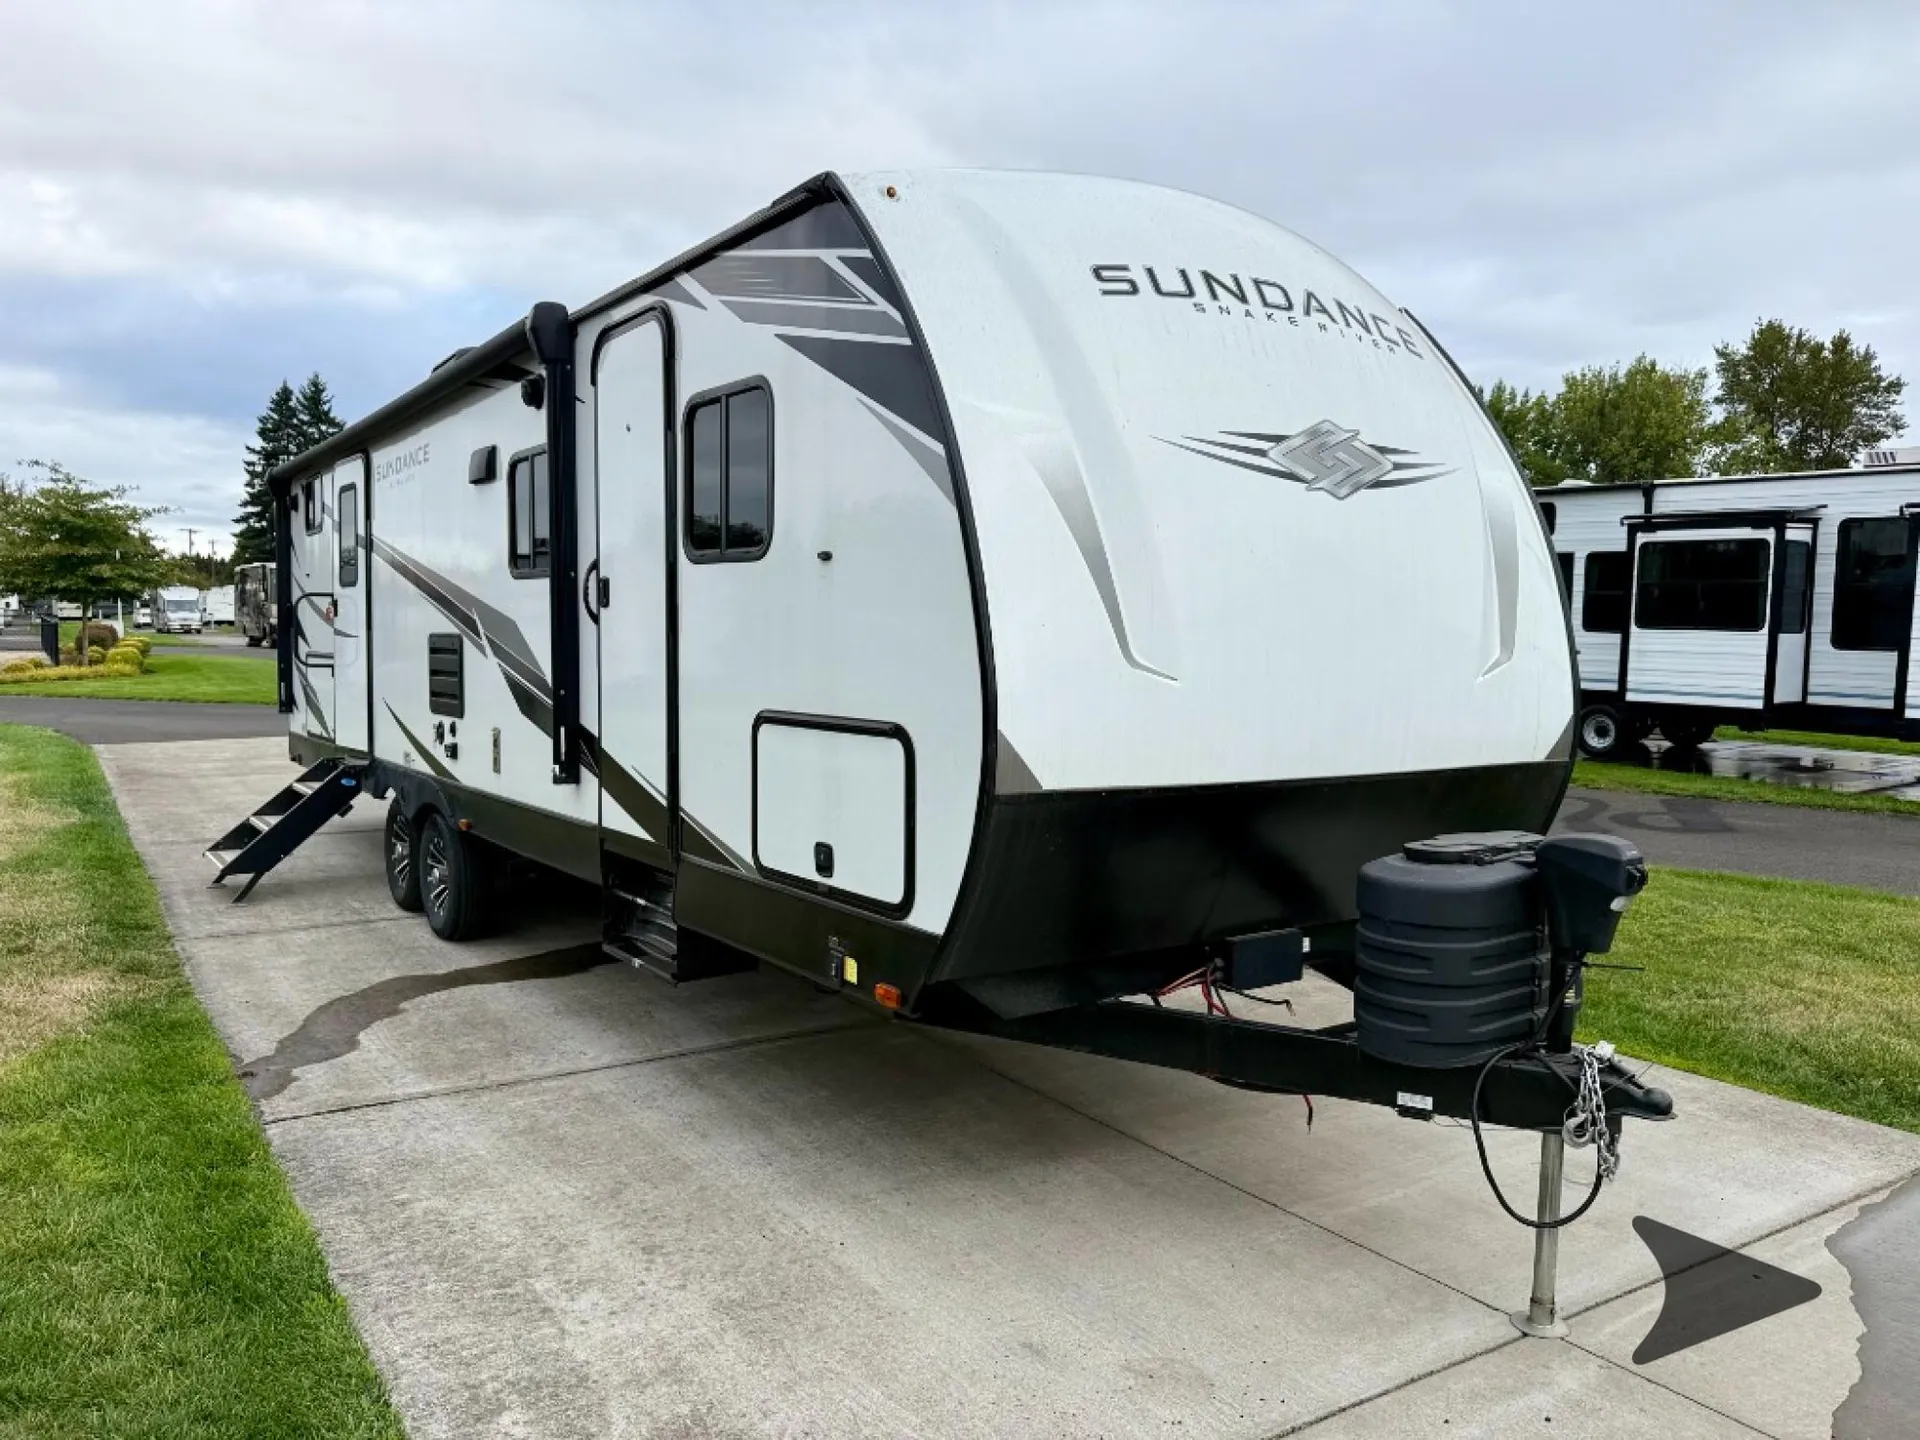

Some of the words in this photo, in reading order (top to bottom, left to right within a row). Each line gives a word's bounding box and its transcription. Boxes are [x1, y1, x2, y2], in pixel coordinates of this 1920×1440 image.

[1089, 263, 1425, 360] SUNDANCE
[1193, 301, 1299, 327] SNAKE
[376, 442, 430, 484] SUNDANCE
